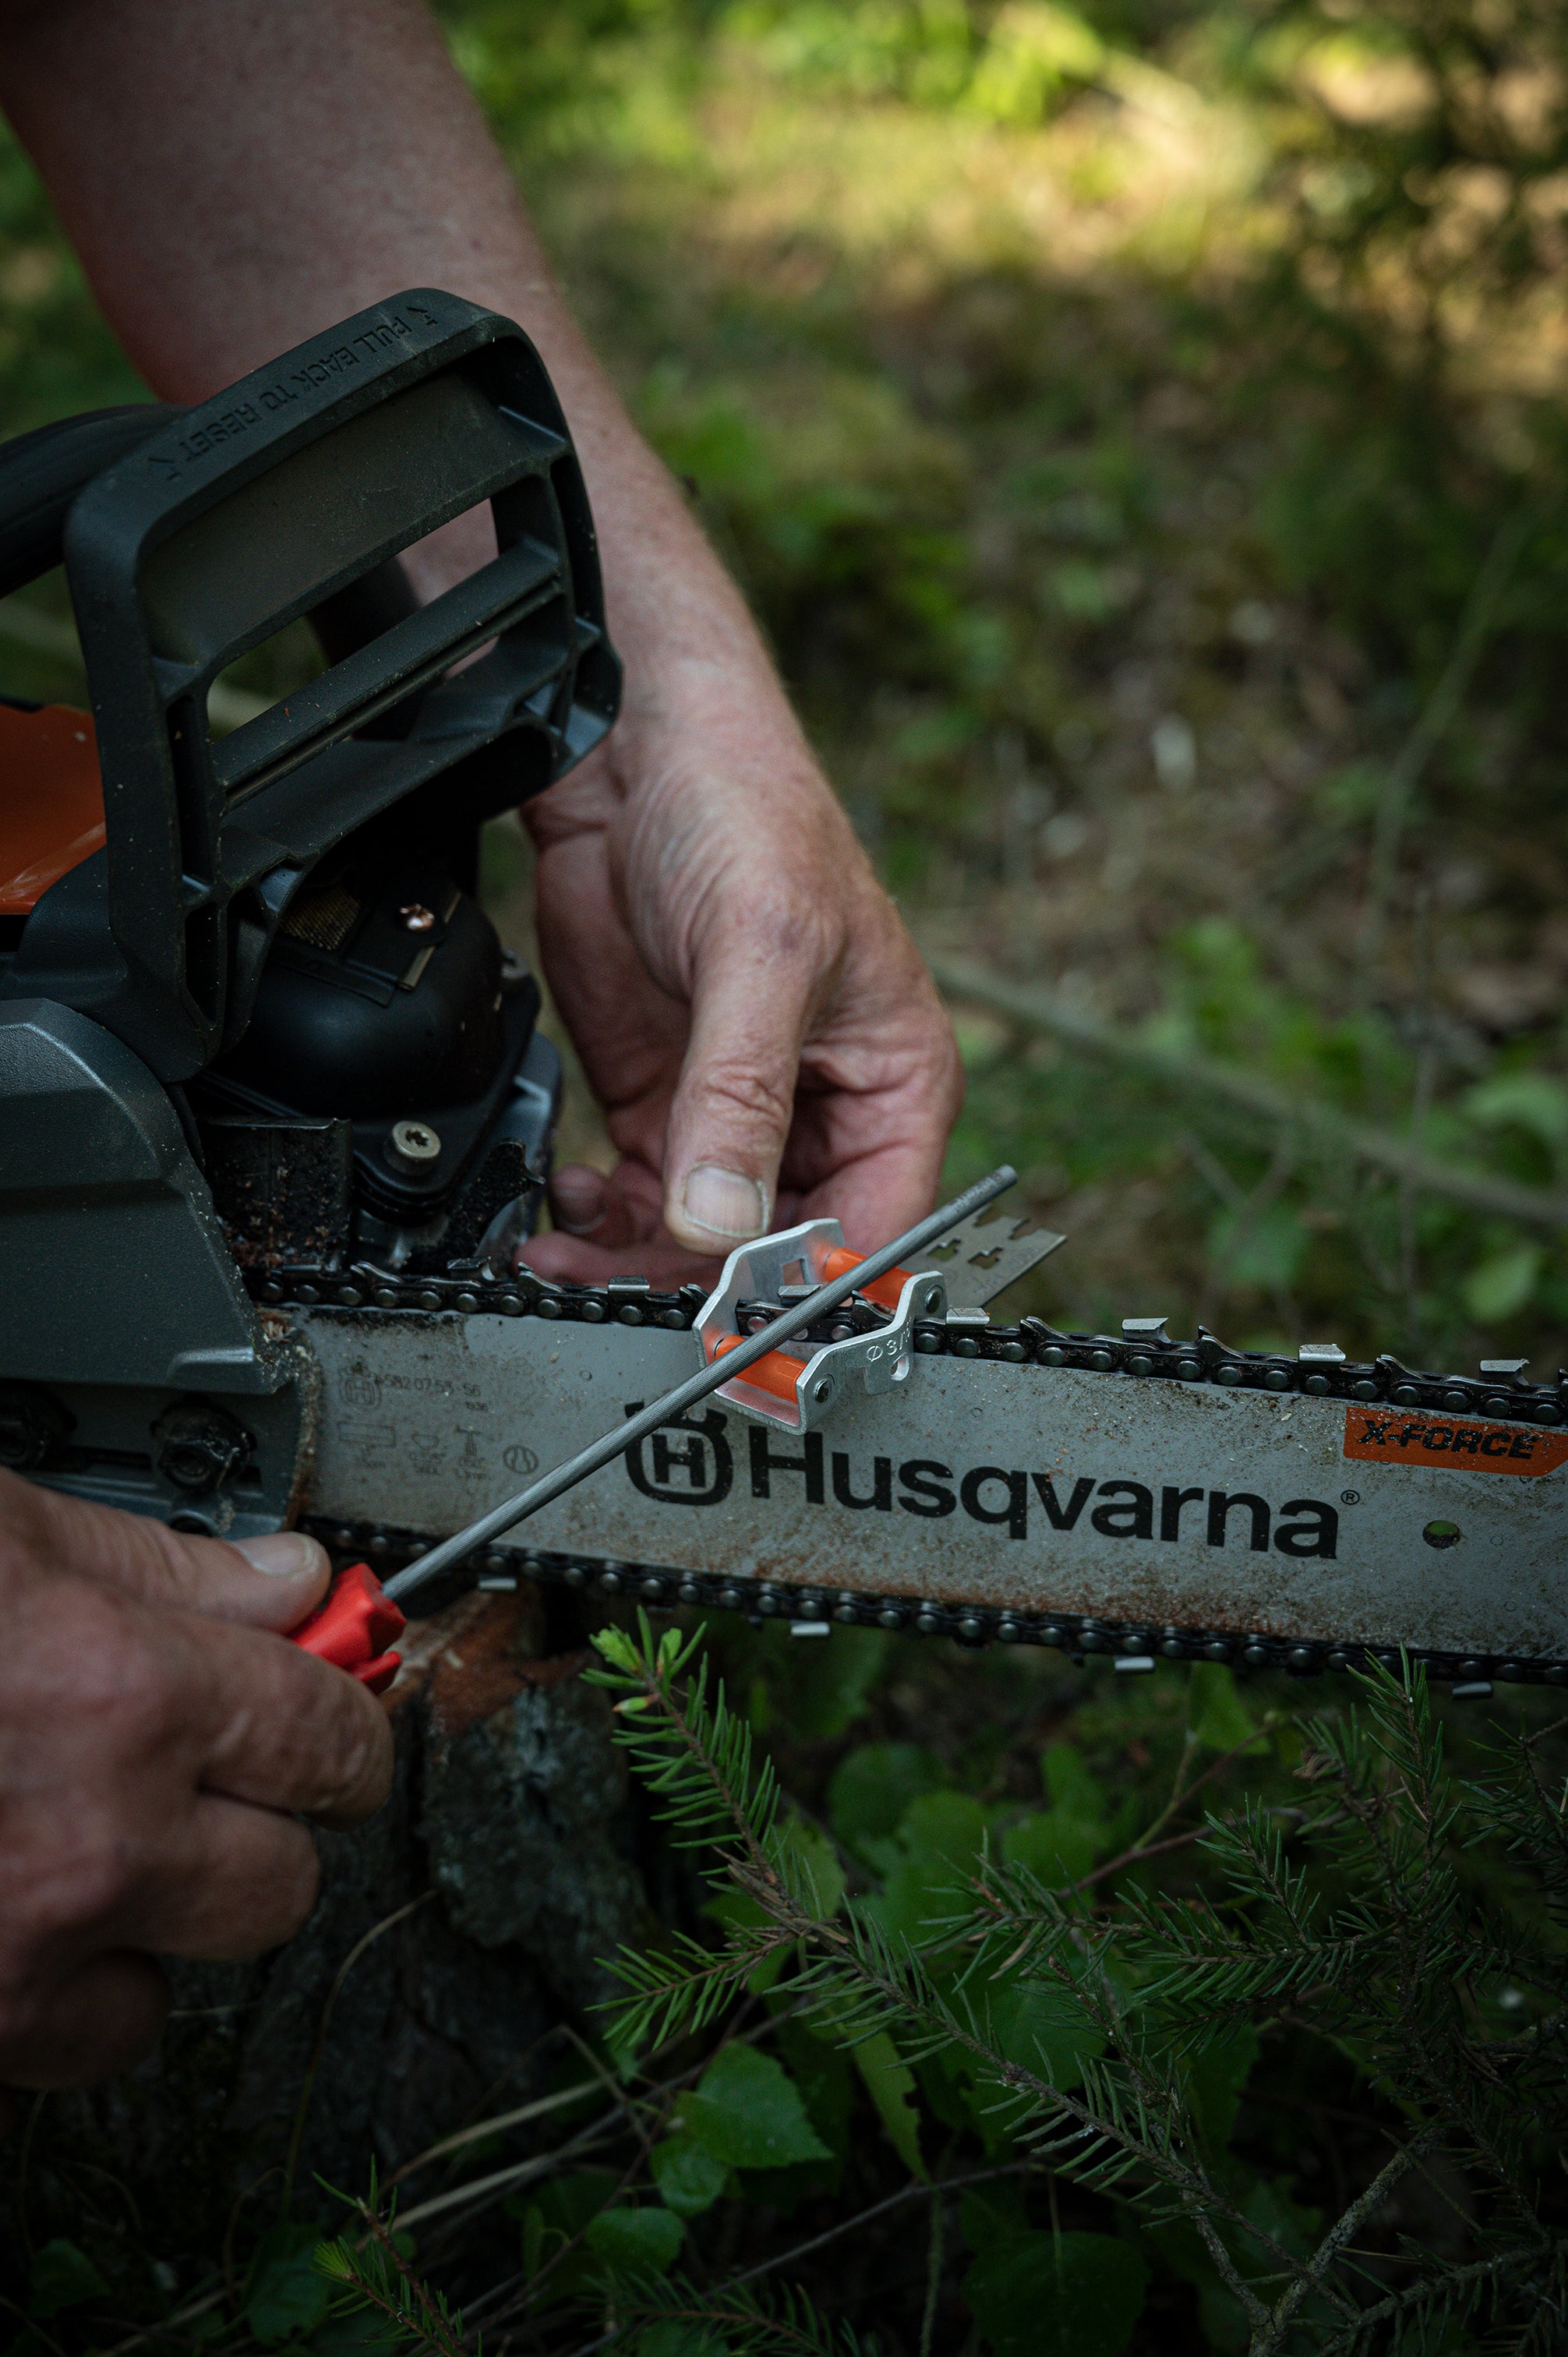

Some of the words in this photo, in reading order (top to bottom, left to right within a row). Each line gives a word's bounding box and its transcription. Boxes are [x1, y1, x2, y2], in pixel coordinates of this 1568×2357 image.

[353, 316, 412, 353] PULL
[291, 346, 359, 390] BACK
[260, 384, 299, 411] TO
[179, 402, 263, 462] RESET
[1358, 1419, 1539, 1460] X-FORCE
